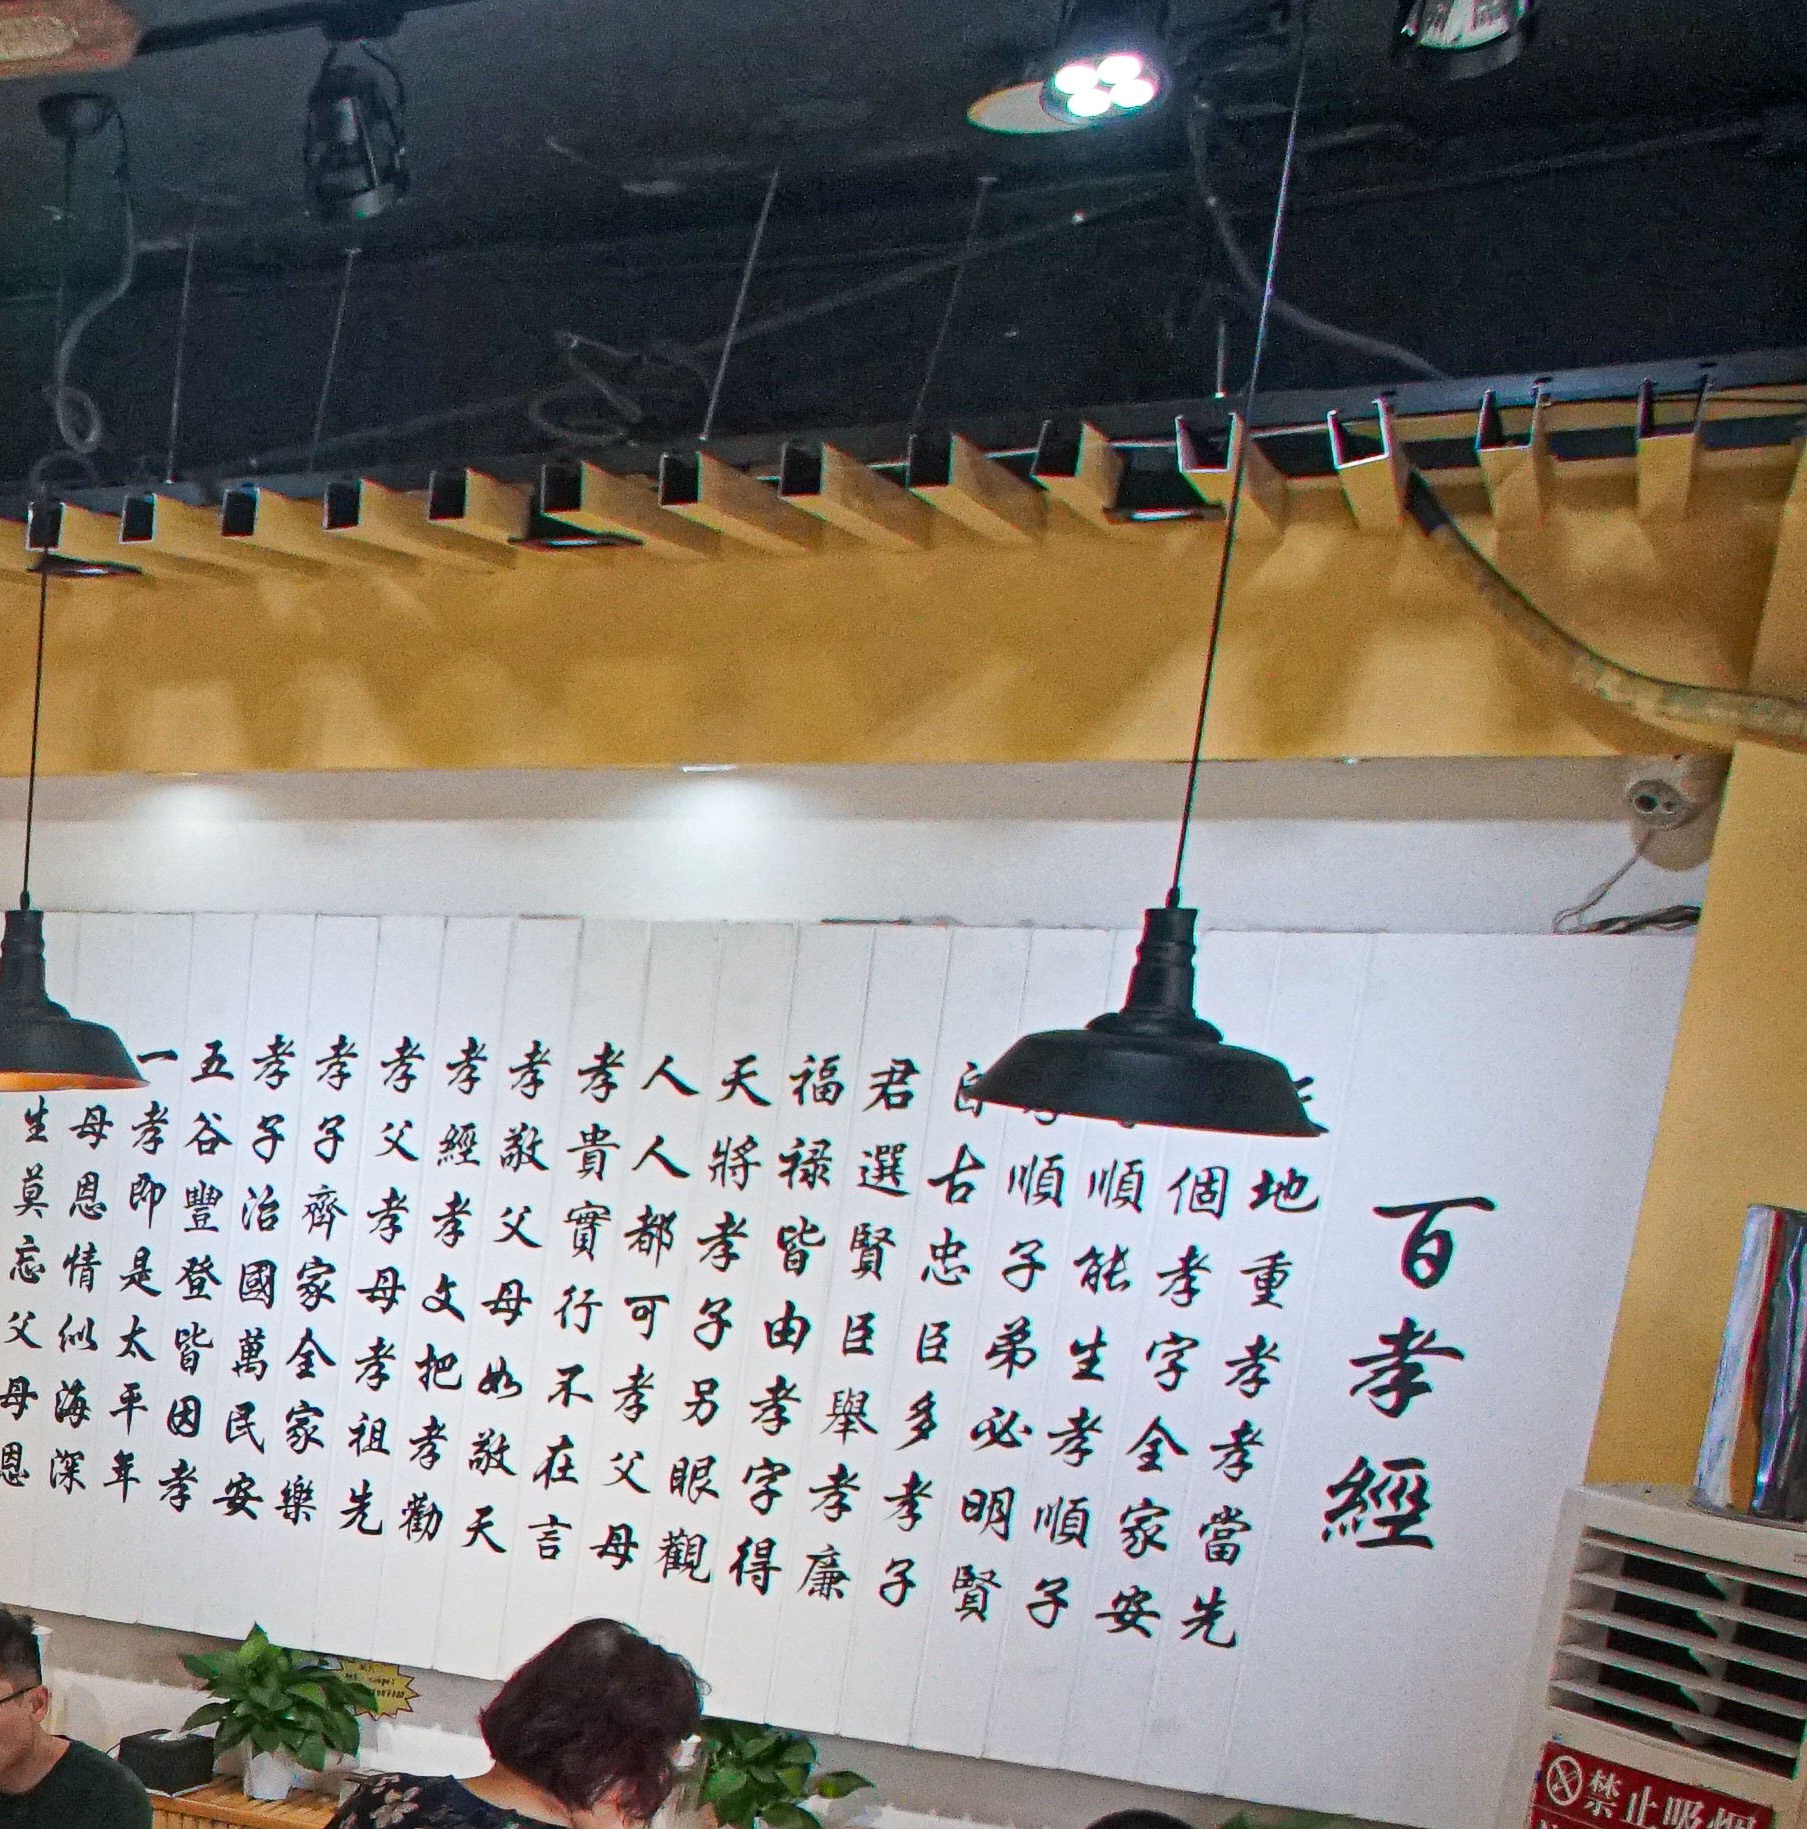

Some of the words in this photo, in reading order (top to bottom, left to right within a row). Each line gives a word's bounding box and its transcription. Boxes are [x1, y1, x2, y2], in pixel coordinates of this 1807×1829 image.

[49, 1107, 111, 1495] 母恩情似海深
[952, 1108, 1065, 1622] 順子弟必明賢
[1026, 1120, 1144, 1629] 順能生孝順子
[1095, 1166, 1229, 1639] 個孝字全家安
[1181, 1077, 1319, 1649] 地重孝孝當先
[1321, 1197, 1497, 1551] 百孝經
